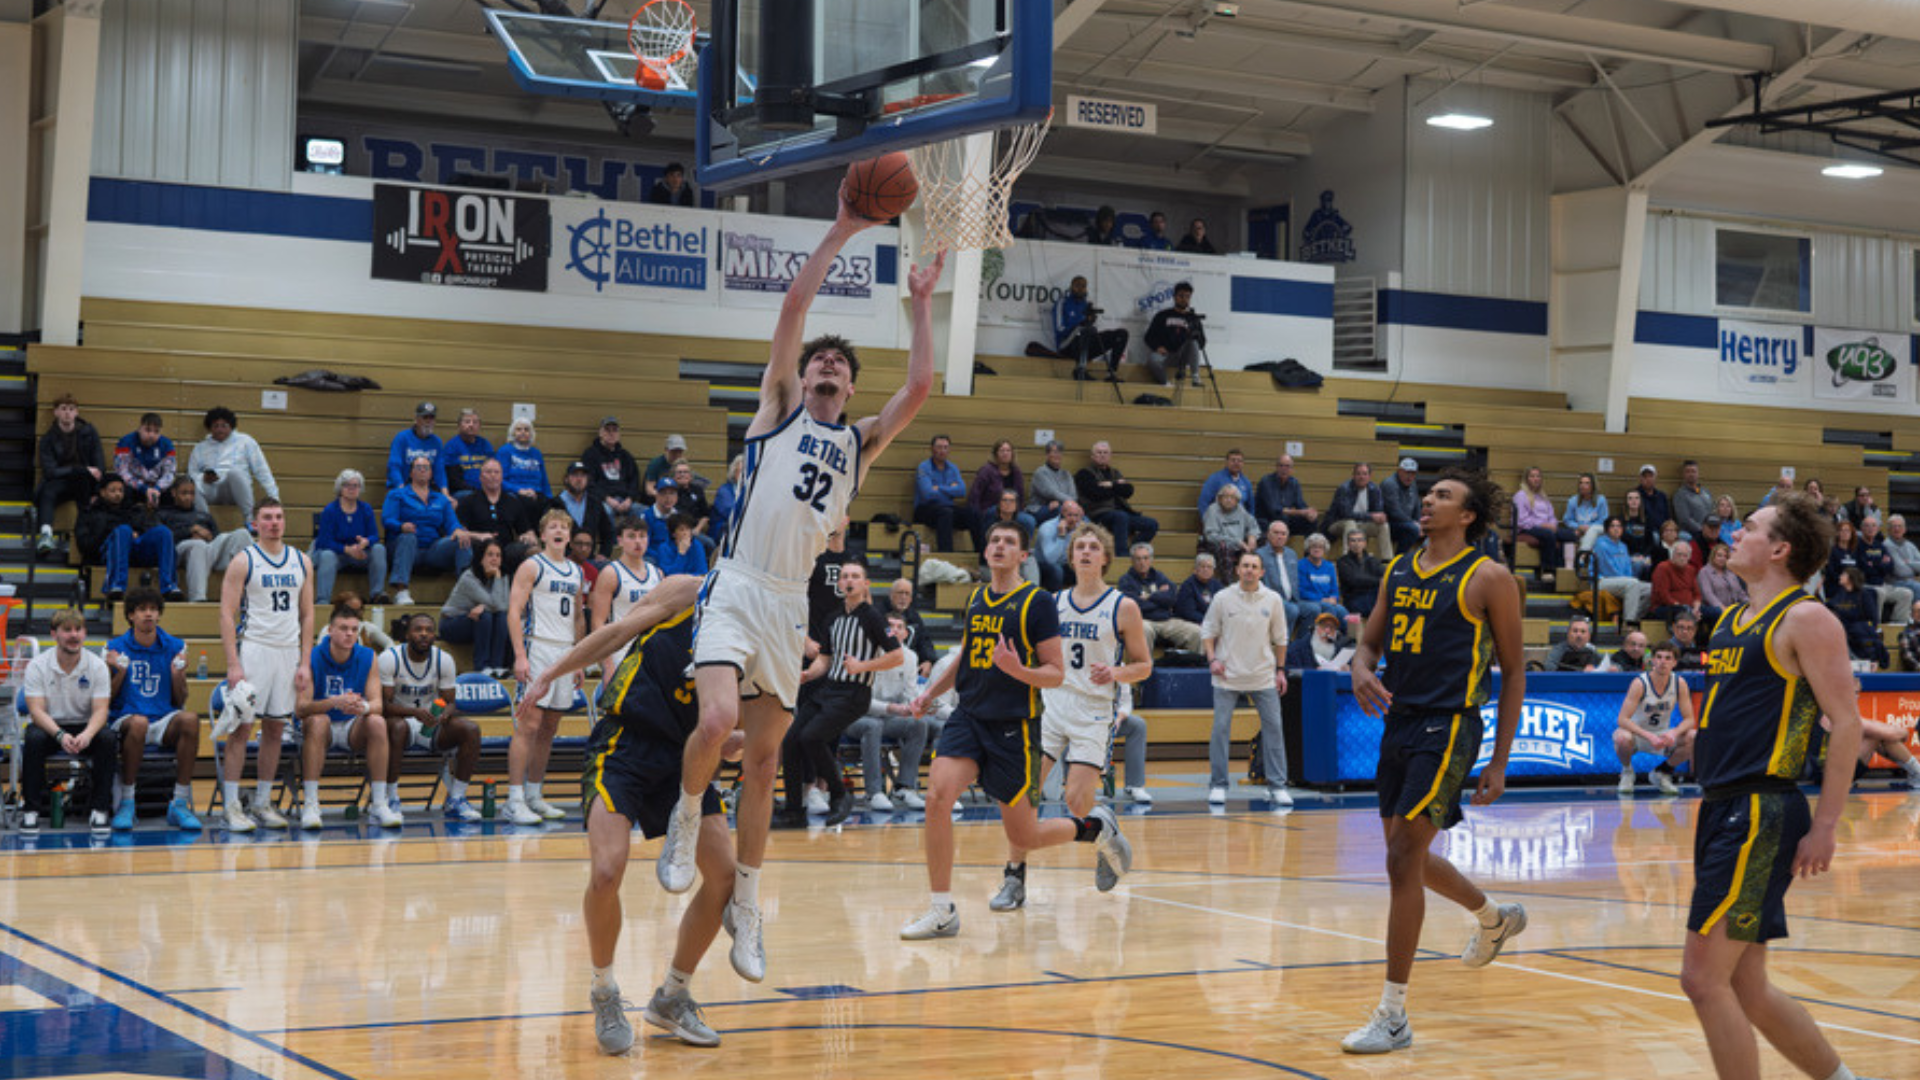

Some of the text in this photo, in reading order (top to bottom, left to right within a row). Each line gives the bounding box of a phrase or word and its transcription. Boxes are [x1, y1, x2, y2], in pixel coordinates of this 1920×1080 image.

[1077, 100, 1145, 127] RESERVED
[408, 190, 515, 243] IRON
[616, 218, 707, 254] Bethel
[464, 251, 513, 265] PHYSICAL
[1299, 239, 1356, 261] BETHEL
[467, 263, 512, 276] THERAPY
[617, 258, 702, 286] Alumni
[996, 281, 1069, 305] OUTDO
[1721, 330, 1797, 375] Henry
[797, 434, 848, 475] BETHEL
[793, 462, 832, 513] 32
[261, 573, 298, 588] BETHEL
[271, 591, 290, 612] 13
[560, 597, 570, 617] 0
[1393, 586, 1438, 609] SAU
[970, 615, 1004, 633] SAU
[1390, 613, 1425, 654] 24
[970, 637, 995, 669] 23
[1071, 643, 1084, 669] 3
[1708, 647, 1744, 675] SAU
[131, 660, 160, 697] BU
[455, 683, 503, 700] BETHEL
[1700, 681, 1719, 728] 1
[1648, 713, 1660, 726] 5
